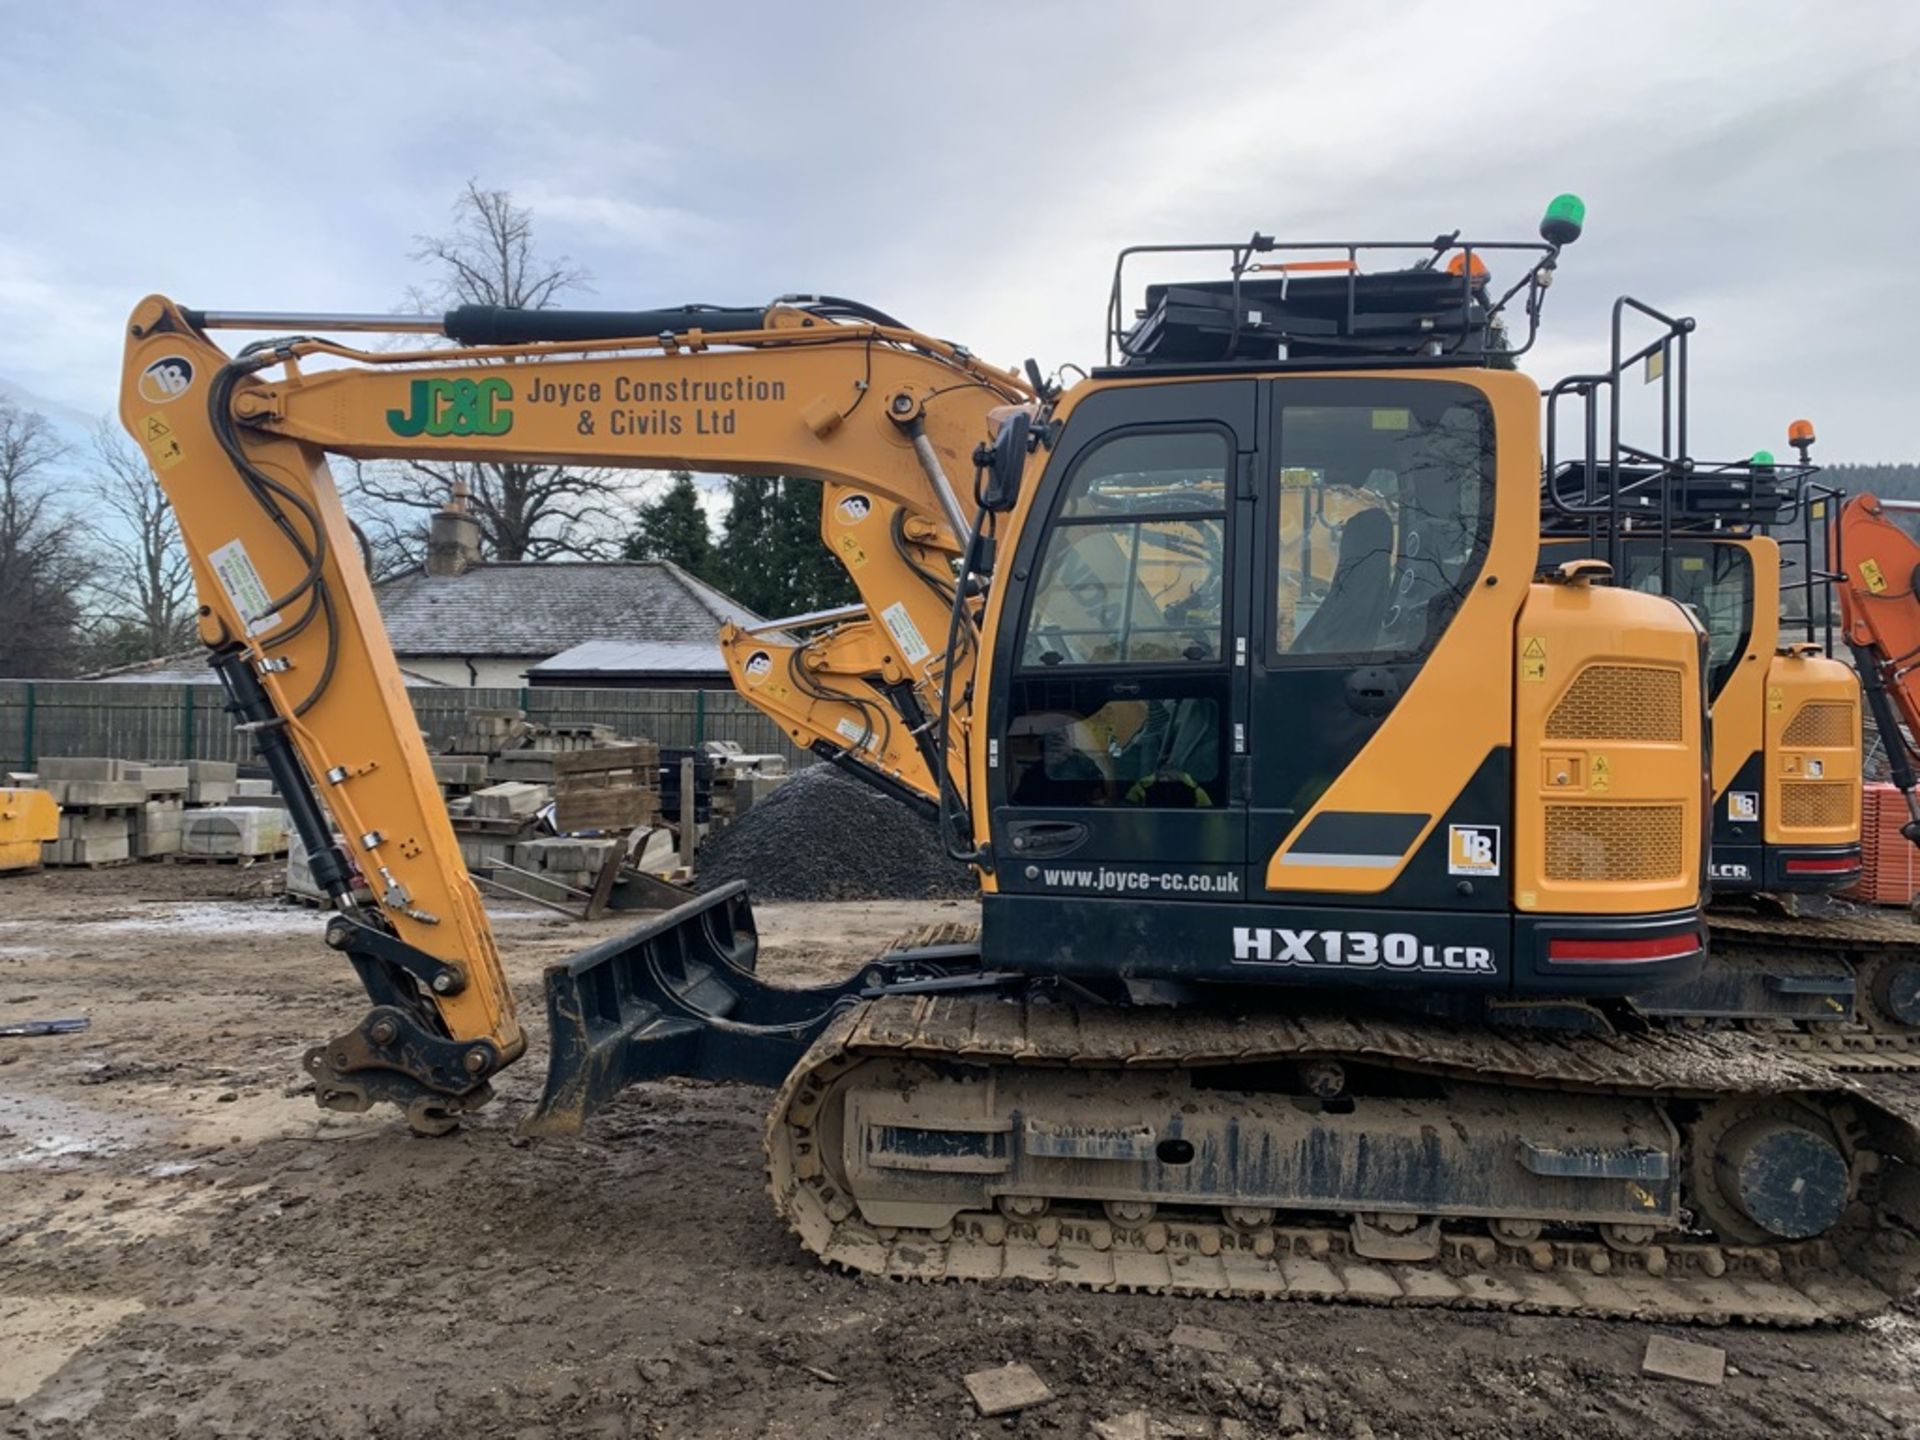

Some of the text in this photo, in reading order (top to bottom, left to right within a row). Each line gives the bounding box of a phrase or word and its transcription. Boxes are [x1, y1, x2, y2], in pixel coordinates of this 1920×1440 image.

[386, 376, 514, 438] JC&C
[526, 375, 785, 407] Joyce Construction
[576, 408, 736, 436] & Civils Ltd
[1456, 830, 1492, 863] TB
[1043, 867, 1240, 893] www.joyce-cc.co.uk
